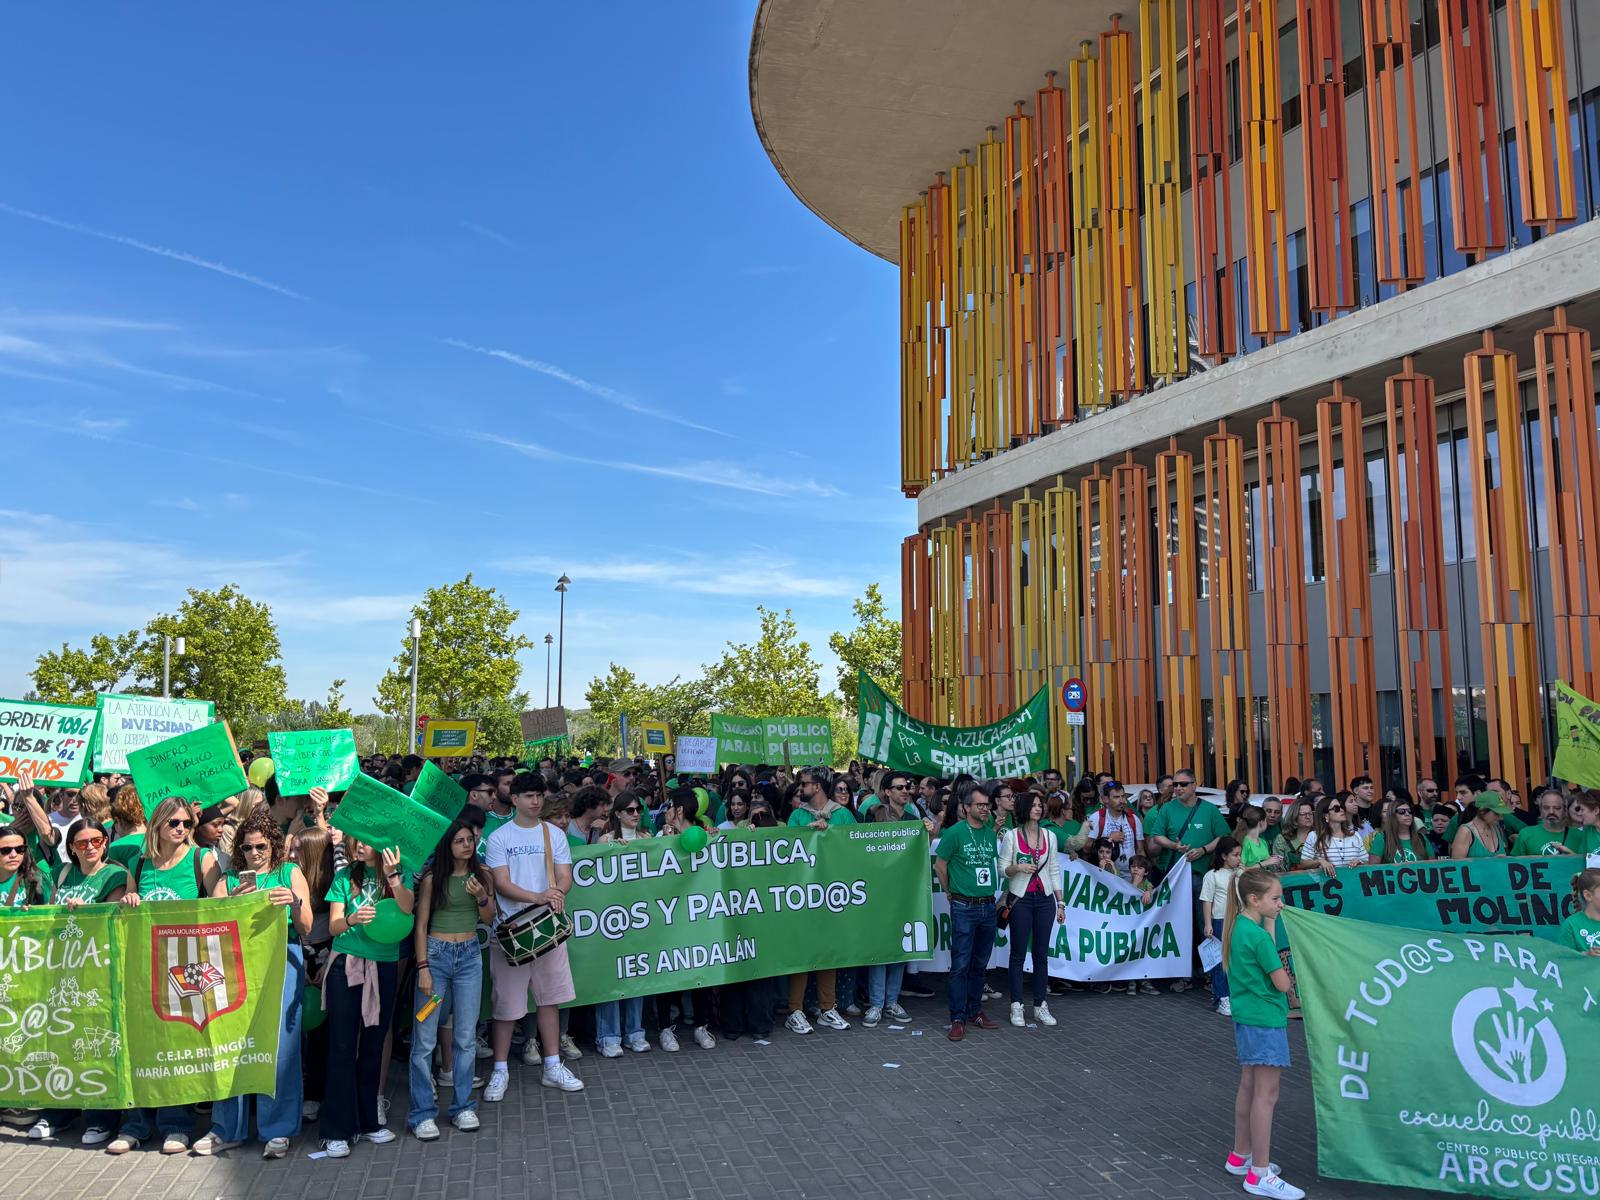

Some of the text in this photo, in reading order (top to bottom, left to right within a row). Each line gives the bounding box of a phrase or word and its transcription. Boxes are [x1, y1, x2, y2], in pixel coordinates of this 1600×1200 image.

[0, 711, 54, 731] ORDEN
[121, 718, 193, 733] DIVERSIDAD
[931, 728, 950, 745] LA
[146, 744, 188, 768] DINERO
[145, 786, 171, 804] PARA
[180, 777, 192, 788] LA
[849, 827, 920, 839] Educación pública
[690, 835, 817, 872] PÚBLICA,
[866, 842, 906, 852] de calidad
[1508, 862, 1552, 892] DE
[657, 897, 680, 926] Y
[687, 886, 764, 922] PARA
[768, 880, 868, 913] TOD@S
[201, 925, 230, 935] SCHOOL
[1079, 921, 1181, 966] PÚBLICA
[616, 935, 757, 980] IES ANDALÁN
[1338, 1045, 1370, 1100] DE
[1462, 939, 1563, 989] PARA
[157, 1049, 193, 1062] C.E.I.P.
[136, 1066, 171, 1079] MARÍA
[173, 1059, 230, 1076] MOLINER
[1400, 1099, 1505, 1132] escuela
[1437, 1141, 1489, 1156] CENTRO
[1439, 1152, 1600, 1196] ARCOSU
